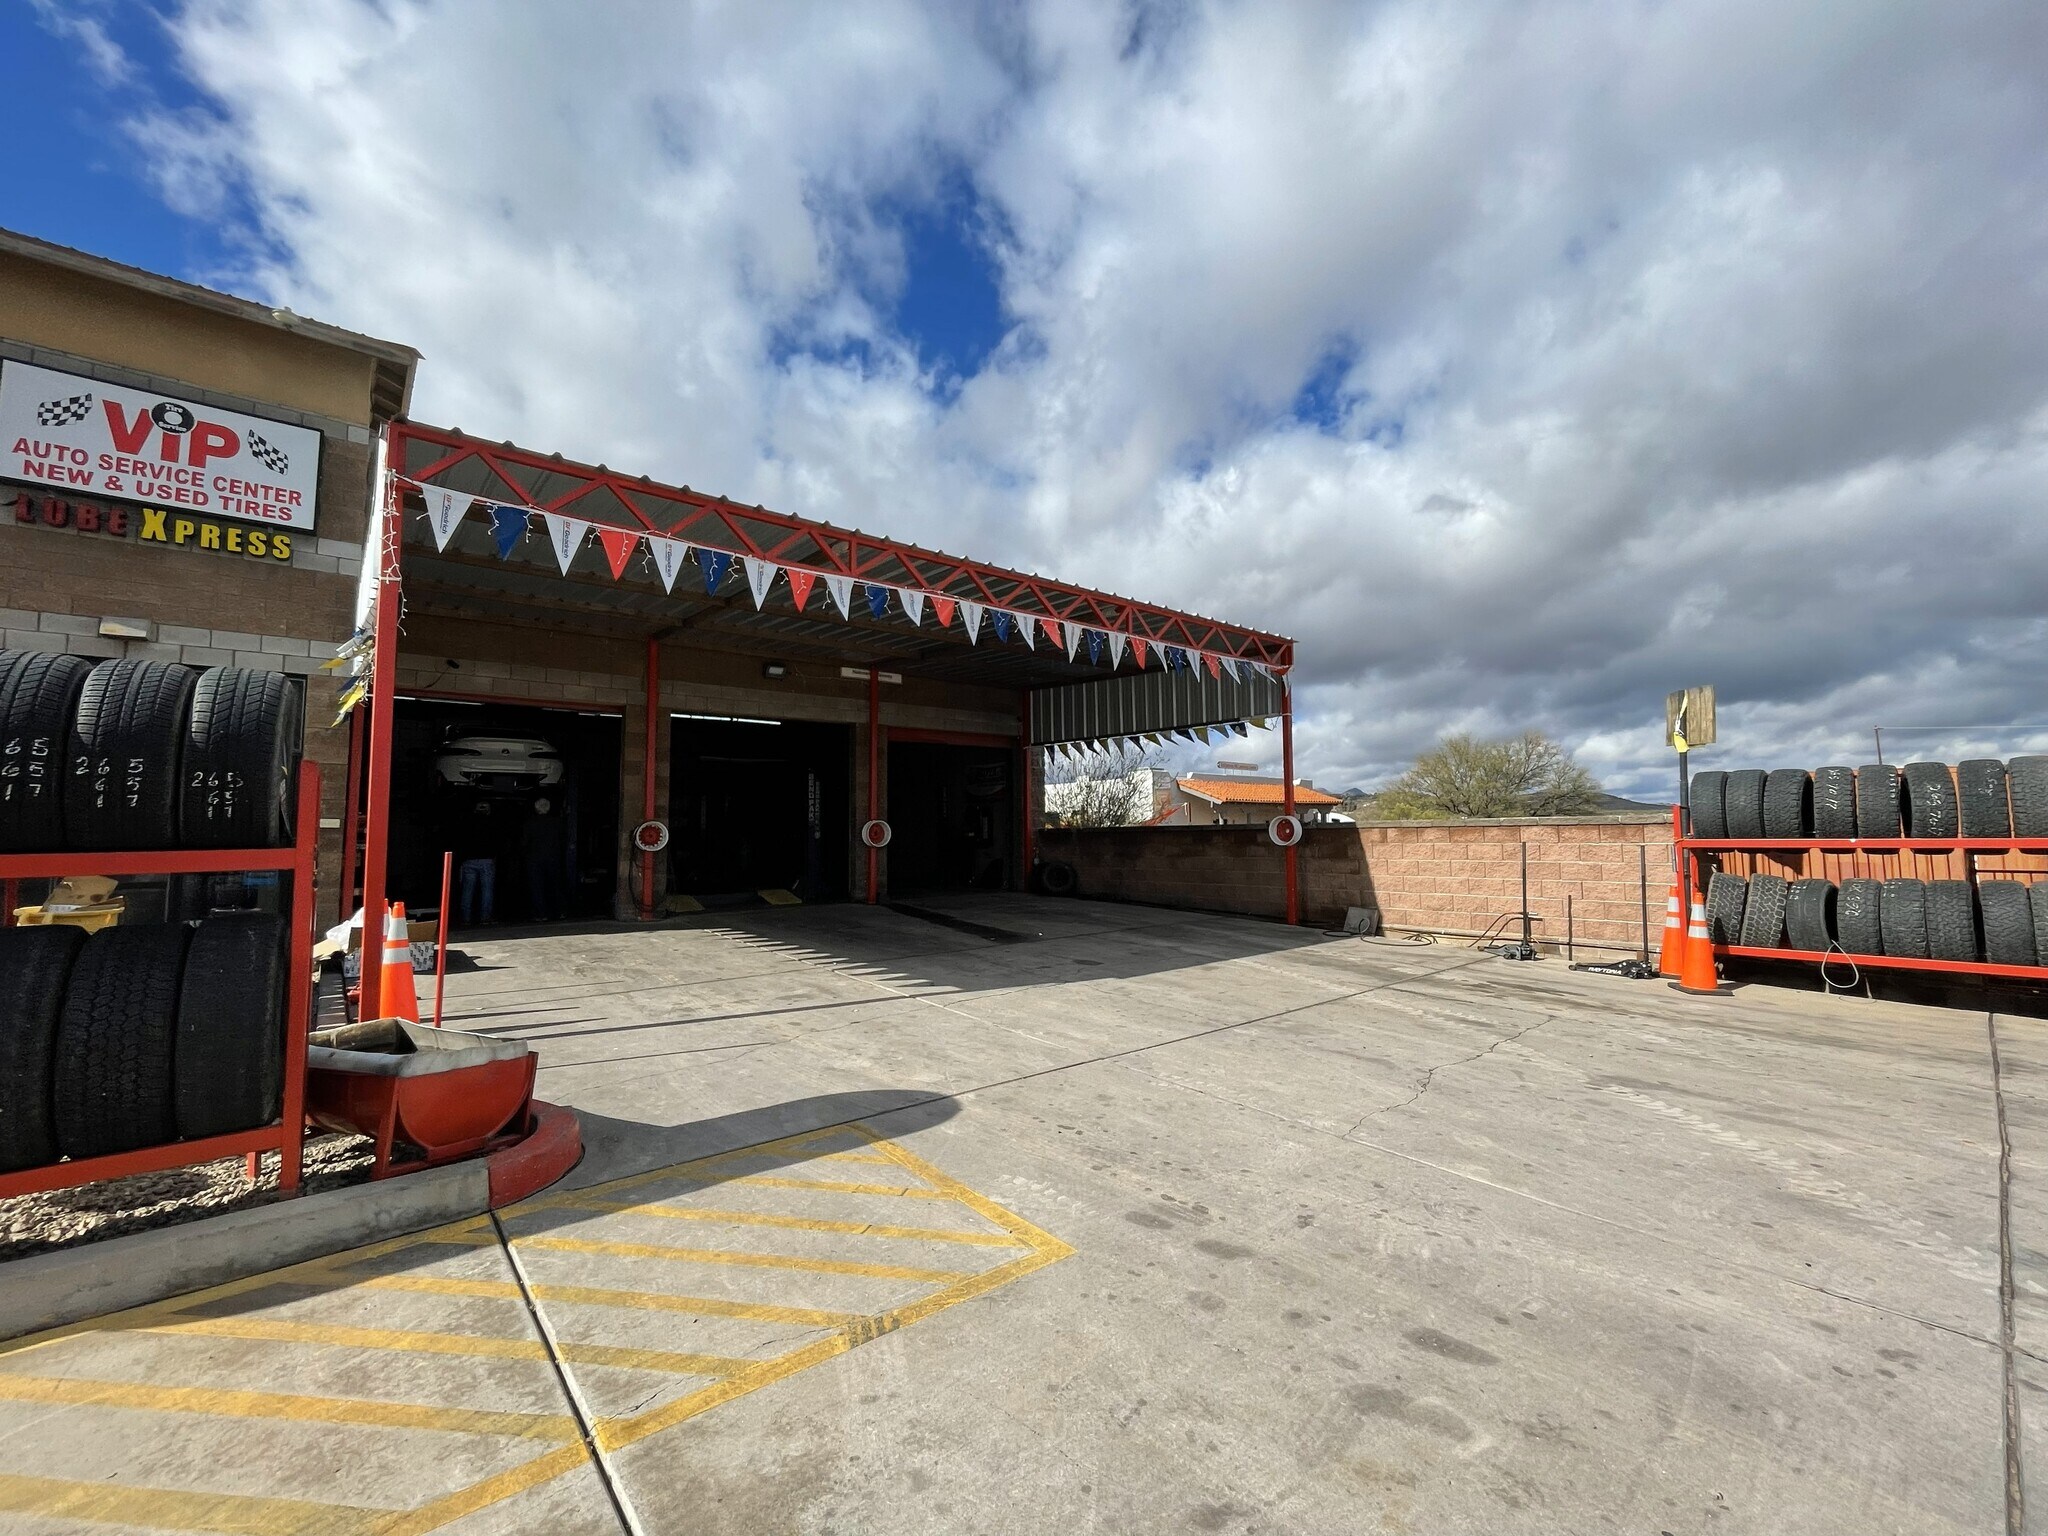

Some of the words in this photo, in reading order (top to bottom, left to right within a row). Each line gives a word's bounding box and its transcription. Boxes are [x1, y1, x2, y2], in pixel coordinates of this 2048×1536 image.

[12, 437, 89, 466] AUTO
[98, 453, 205, 487] SERVICE
[212, 475, 302, 506] CENTER
[23, 459, 94, 486] NEW
[104, 475, 124, 491] &
[136, 480, 209, 506] USED
[218, 494, 293, 521] TIRES
[141, 508, 292, 559] XPRESS
